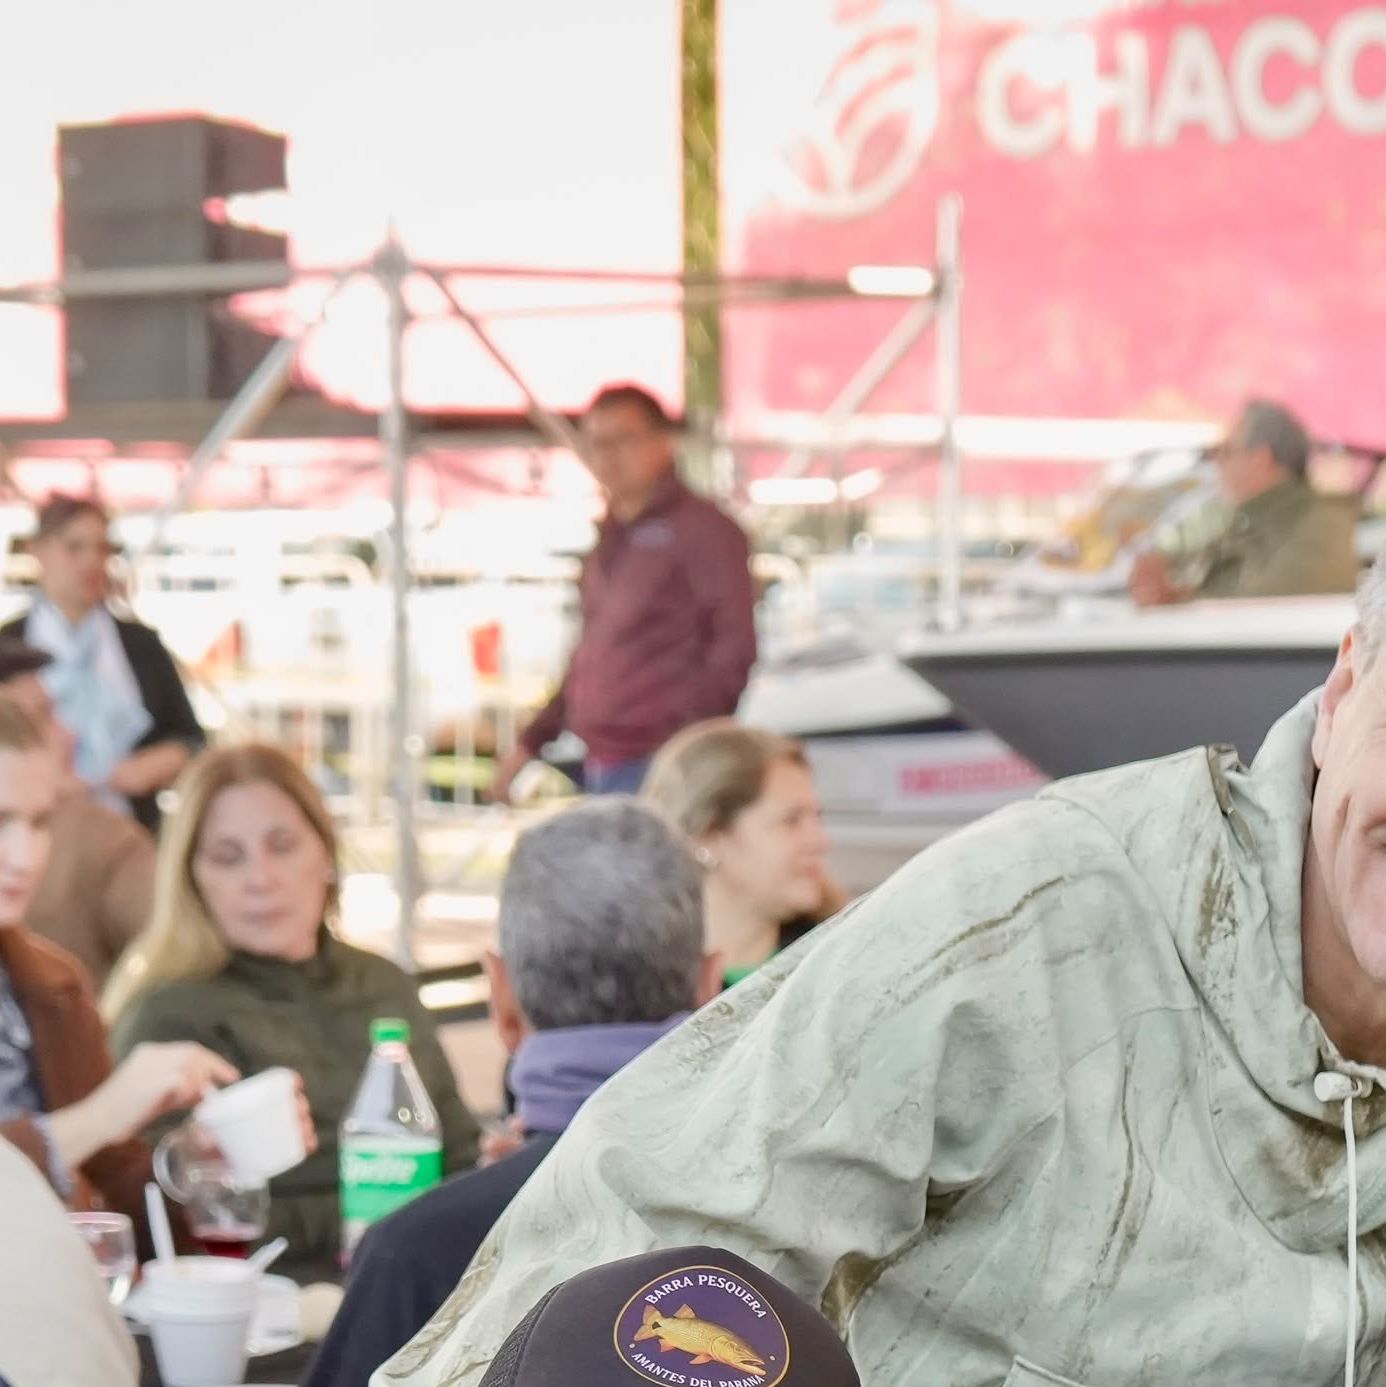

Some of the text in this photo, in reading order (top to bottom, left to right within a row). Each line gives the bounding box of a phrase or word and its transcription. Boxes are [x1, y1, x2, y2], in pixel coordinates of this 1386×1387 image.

[644, 1274, 767, 1319] BARRA PESQUERA
[631, 1352, 686, 1384] AMANTES
